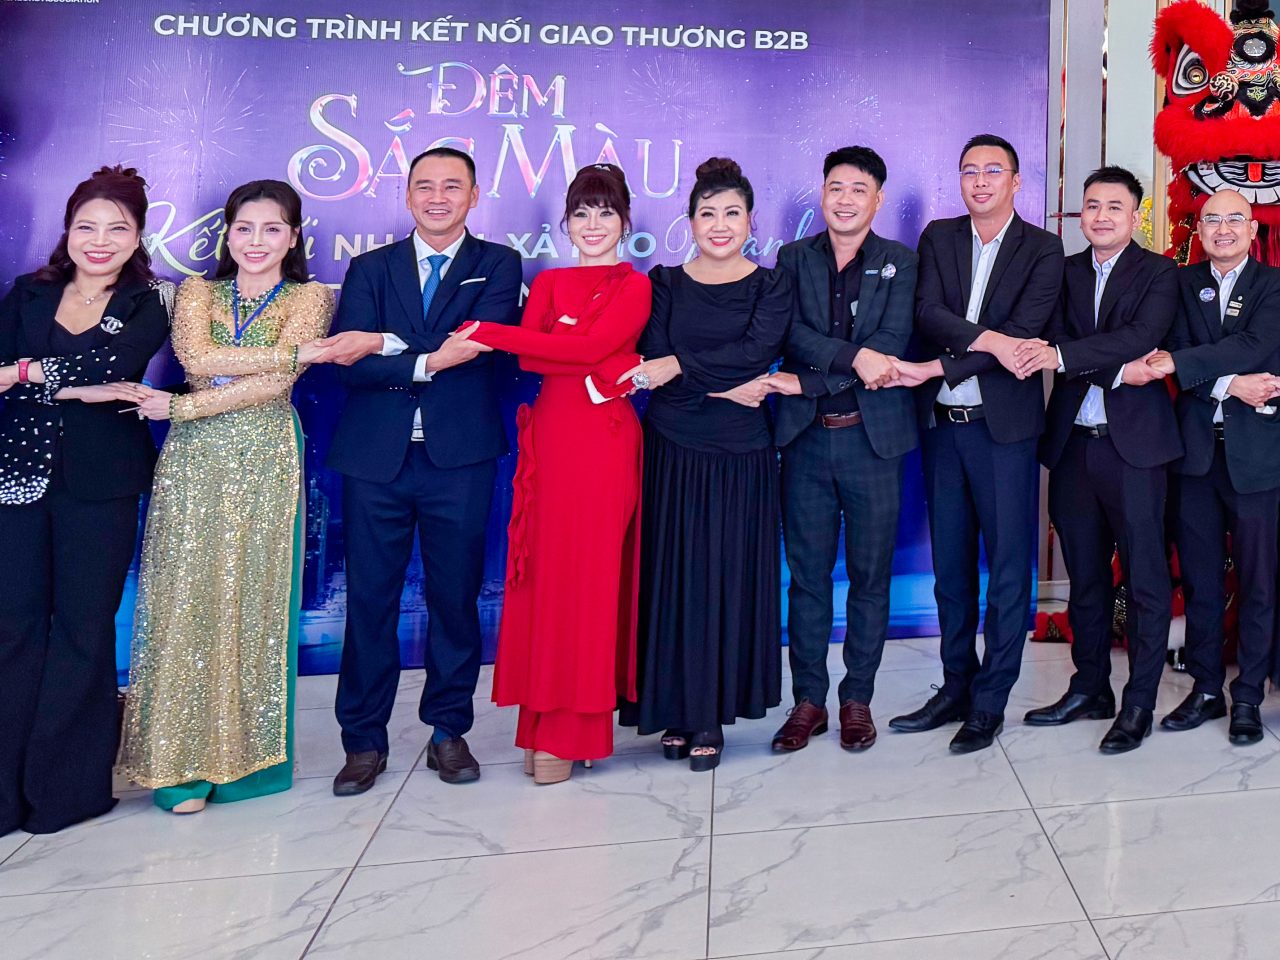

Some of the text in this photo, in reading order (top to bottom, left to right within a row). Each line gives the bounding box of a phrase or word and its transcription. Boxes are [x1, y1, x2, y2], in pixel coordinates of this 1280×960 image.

[153, 12, 809, 50] CHƯƠNG TRÌNH KẾT NỐI GIAO THƯƠNG B2B
[396, 61, 567, 119] ĐÊM
